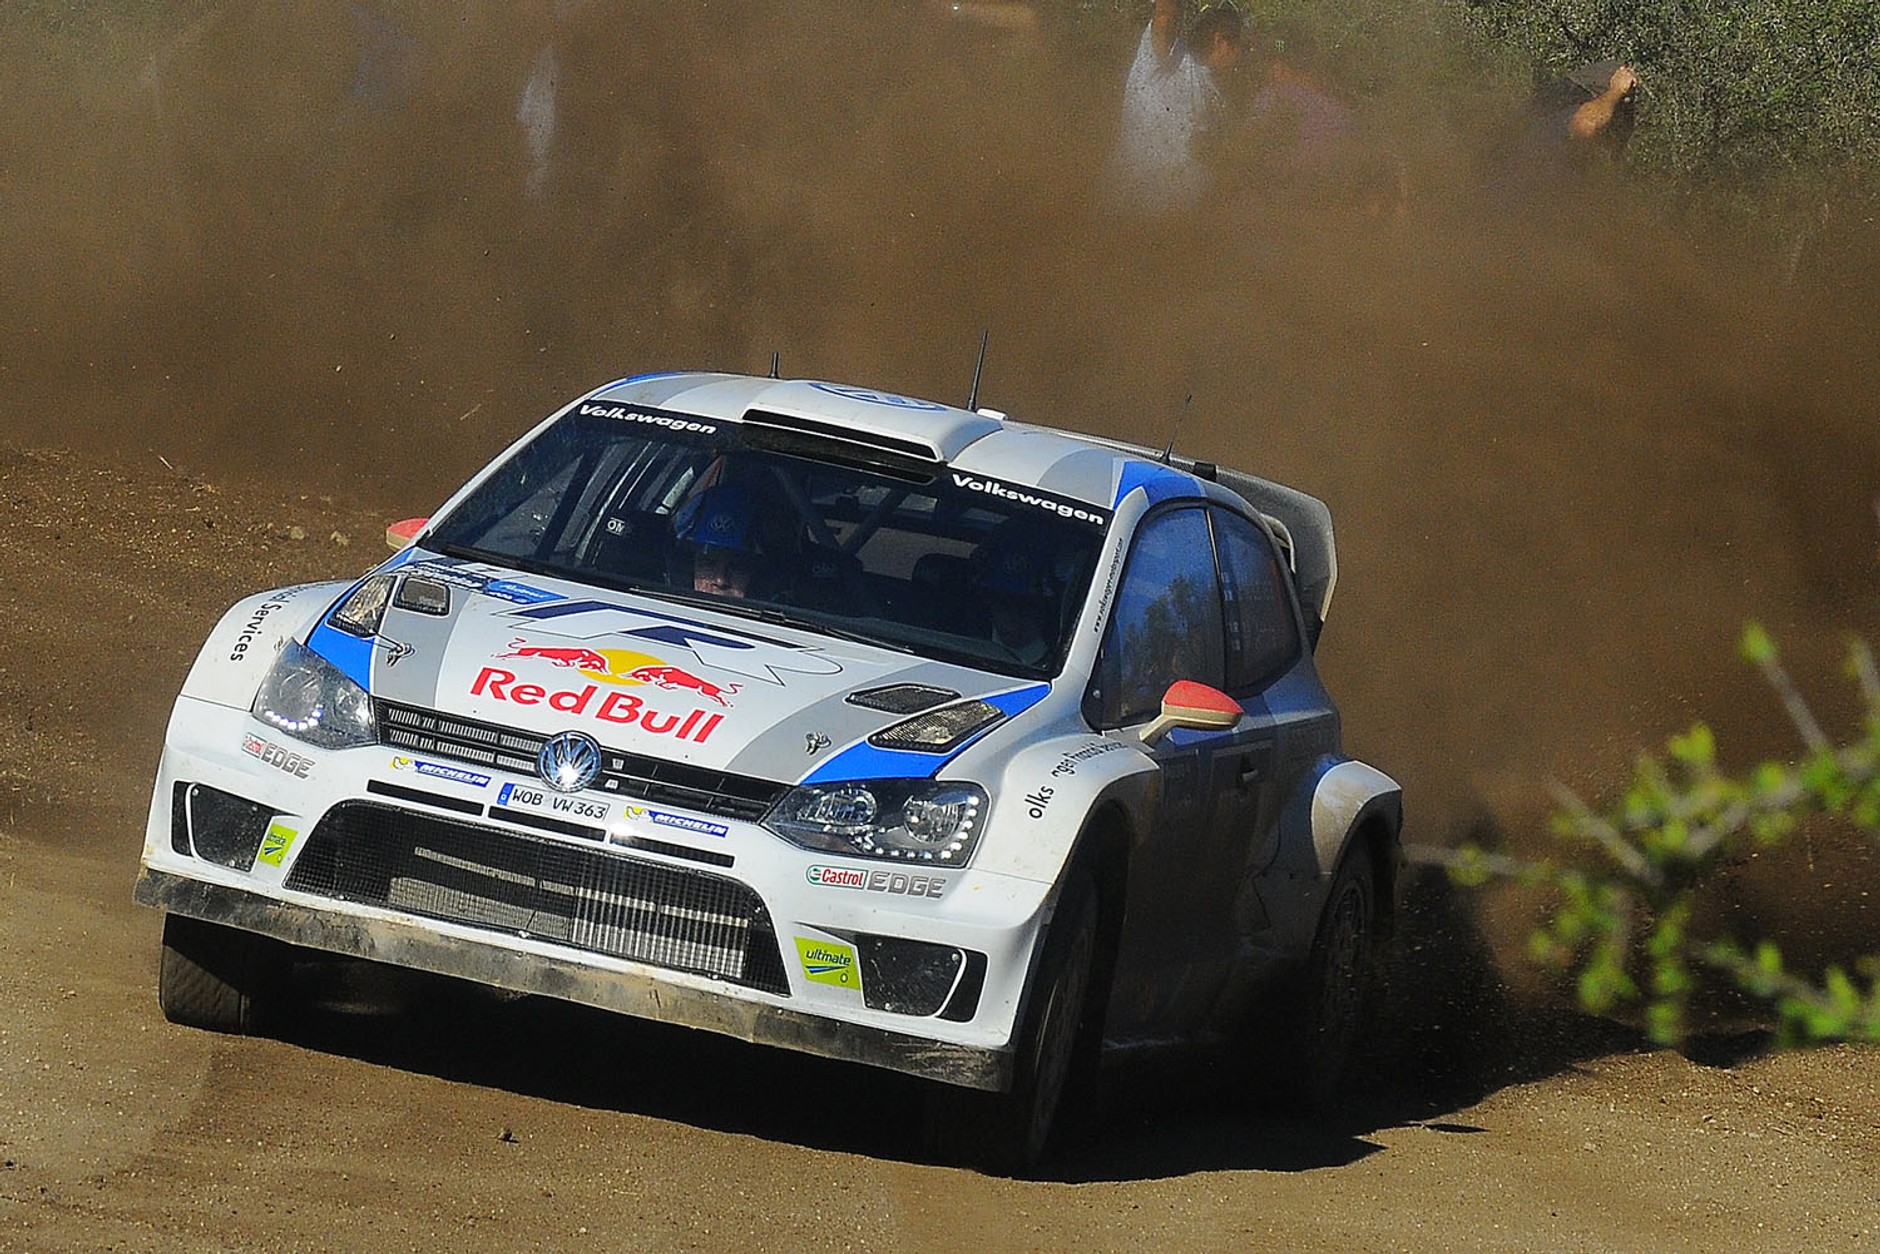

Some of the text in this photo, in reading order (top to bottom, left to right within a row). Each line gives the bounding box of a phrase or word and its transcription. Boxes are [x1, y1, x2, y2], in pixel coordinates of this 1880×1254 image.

[580, 404, 717, 435] Volkswagen
[952, 473, 1105, 526] Volkswagen
[230, 603, 283, 662] Services
[469, 666, 725, 744] Red Bull
[261, 742, 317, 780] EDGE
[419, 763, 490, 786] MICHELIN
[512, 788, 544, 807] WOB
[552, 796, 573, 814] VW
[575, 802, 607, 820] 363
[654, 813, 728, 837] MICHELIN
[821, 868, 947, 899] Castrol EDGE
[805, 947, 852, 967] ultimate
